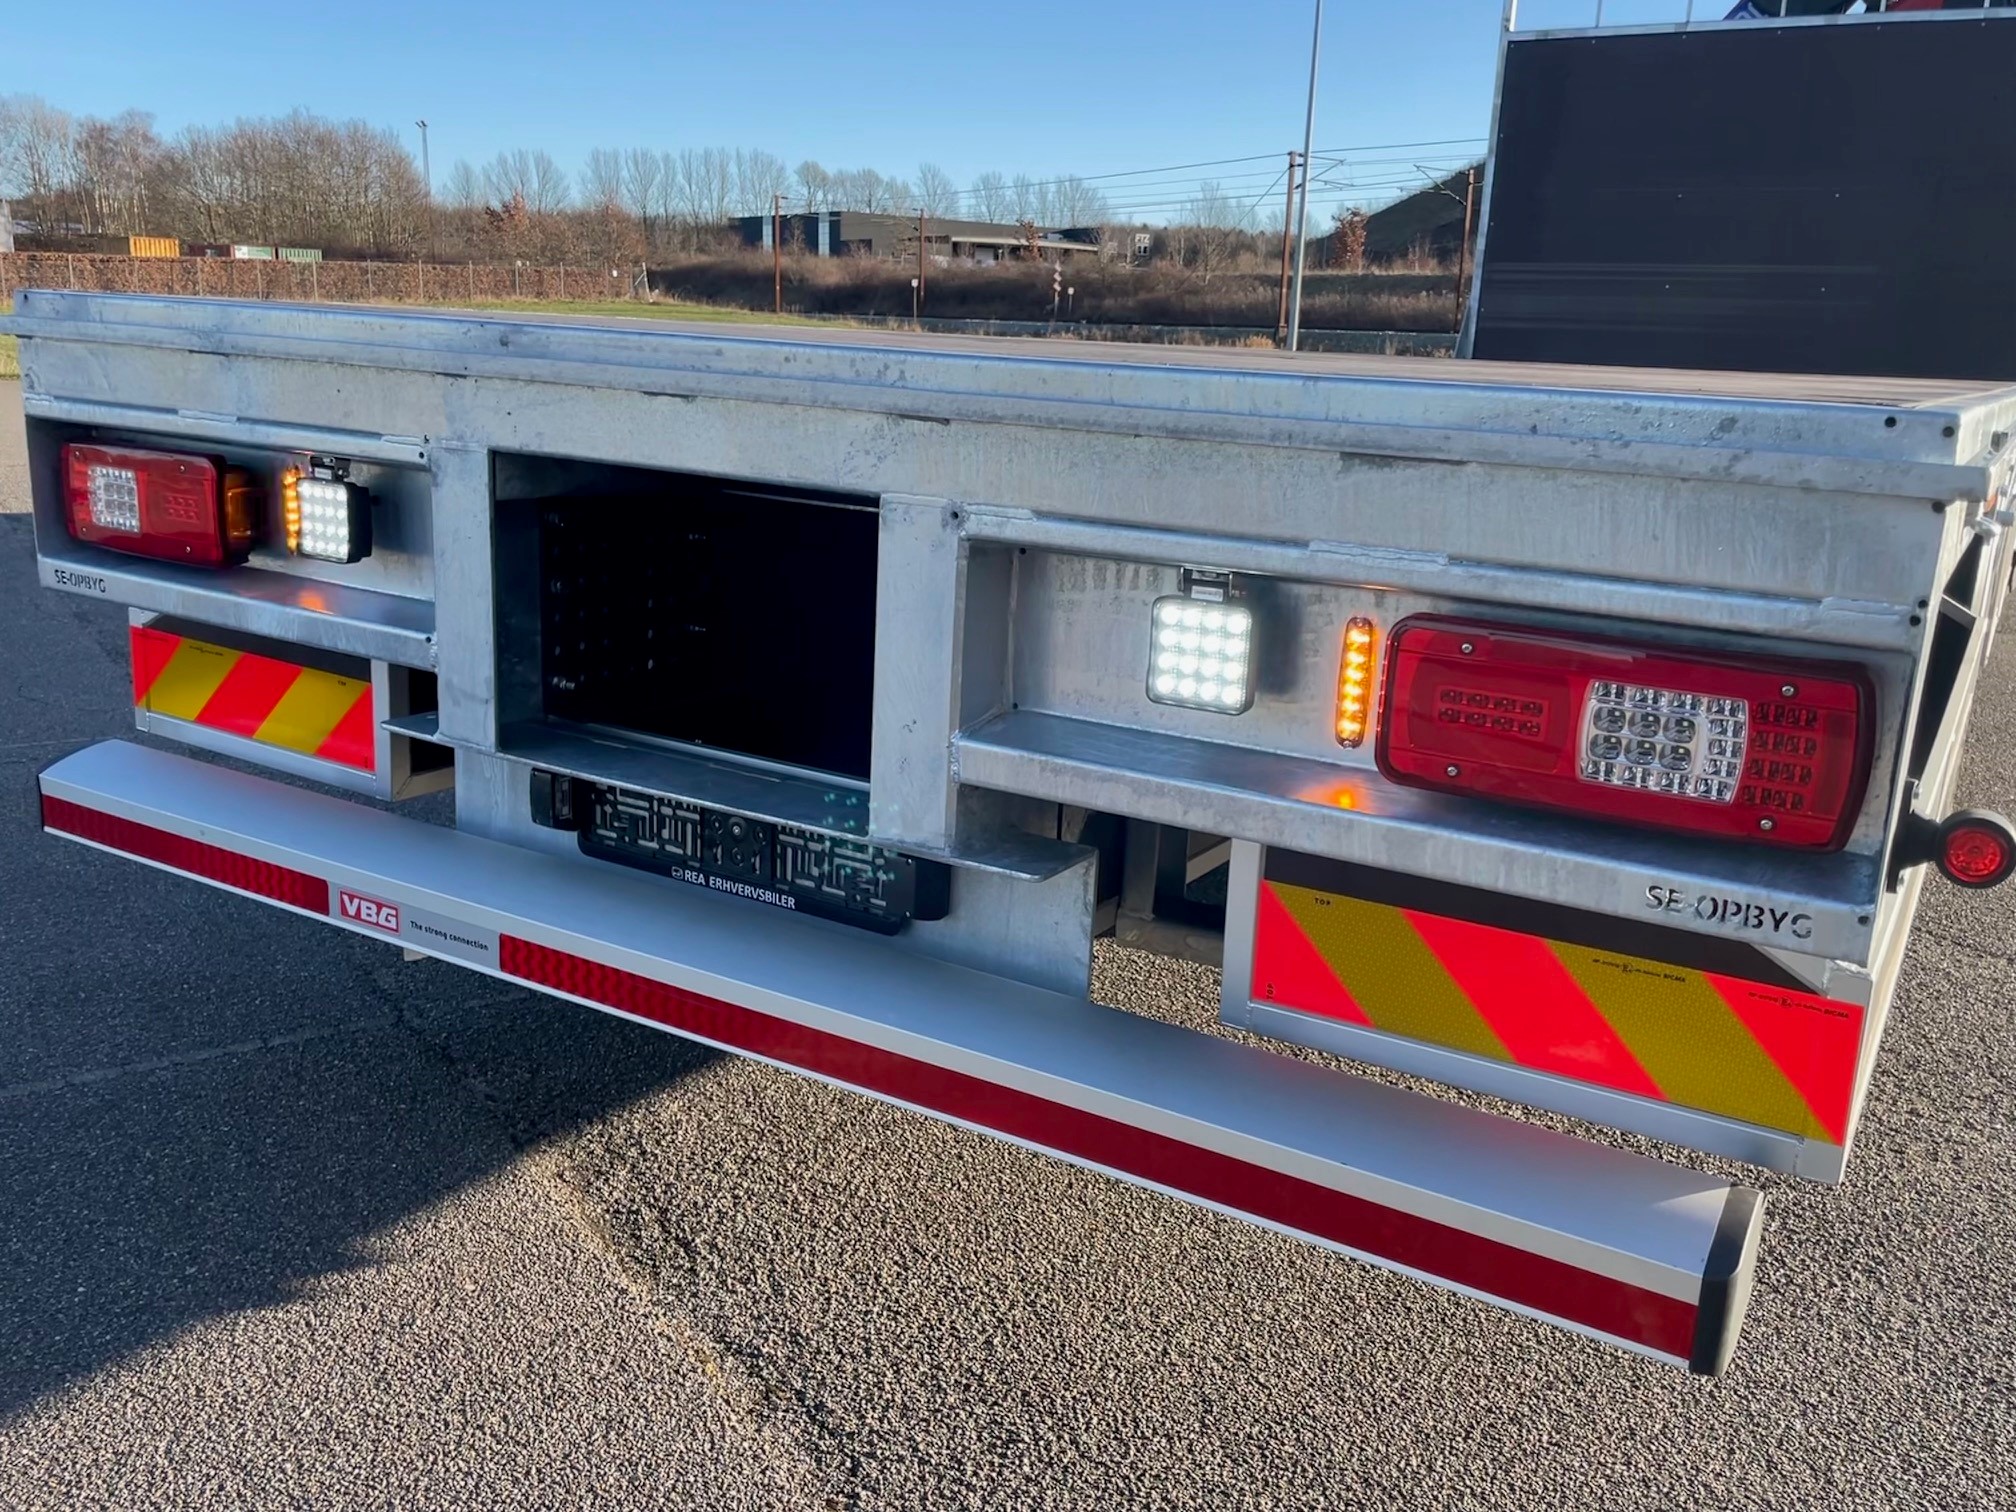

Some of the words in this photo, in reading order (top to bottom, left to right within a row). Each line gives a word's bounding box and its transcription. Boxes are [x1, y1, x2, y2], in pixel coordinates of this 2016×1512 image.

[54, 569, 106, 593] SE-OPBYG
[684, 870, 706, 886] REA
[709, 876, 796, 909] ERHVERVSBILER
[1314, 897, 1331, 906] TOP
[341, 894, 398, 929] VBG
[410, 920, 423, 932] The
[424, 926, 448, 940] strong
[449, 933, 490, 951] connection
